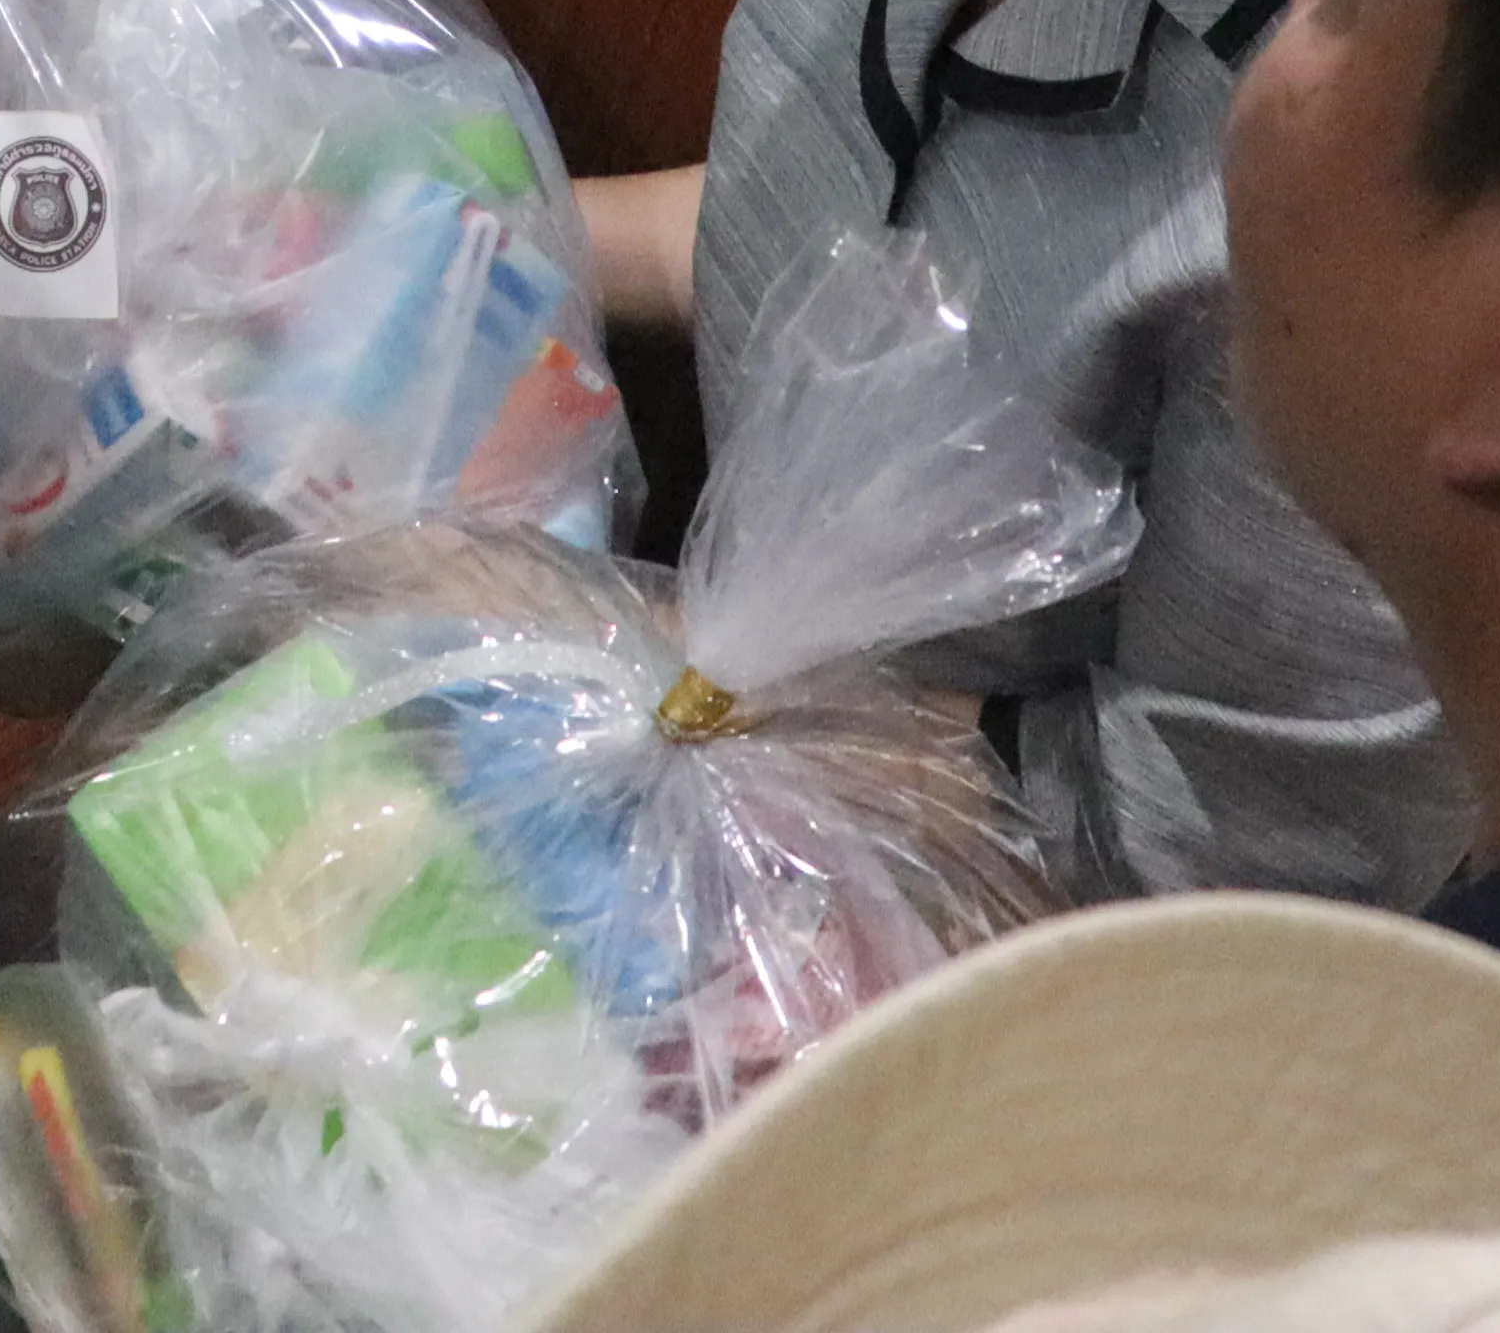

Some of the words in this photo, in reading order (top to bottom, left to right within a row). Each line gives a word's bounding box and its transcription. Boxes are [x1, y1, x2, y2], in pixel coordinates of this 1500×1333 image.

[25, 174, 60, 186] POLICE
[19, 252, 58, 266] POLICE
[60, 221, 100, 262] STATION
